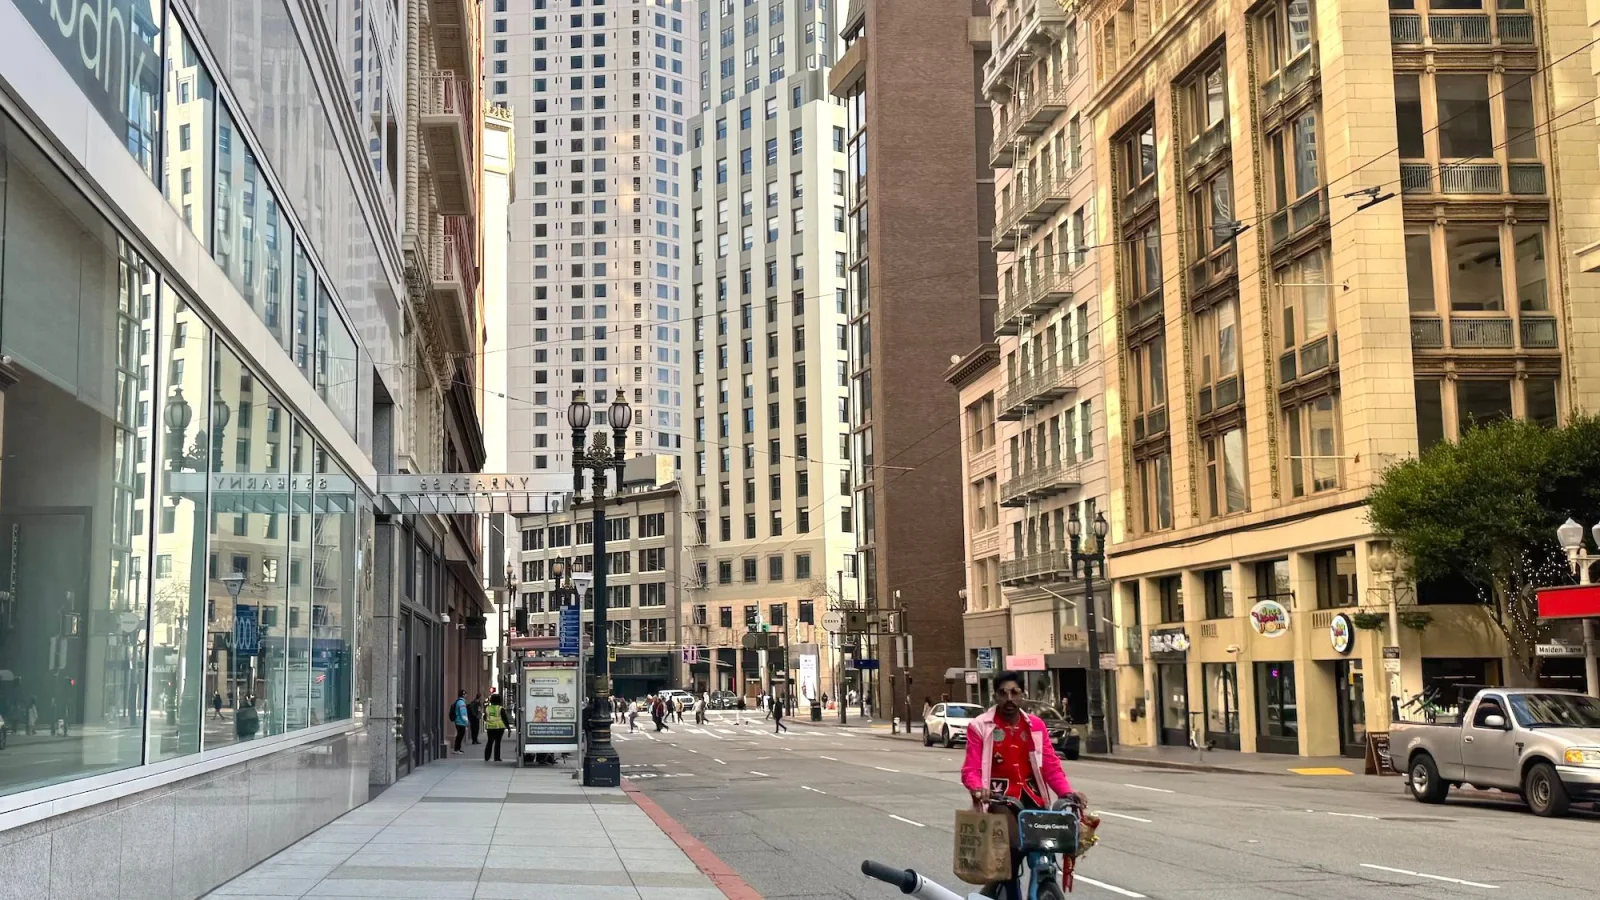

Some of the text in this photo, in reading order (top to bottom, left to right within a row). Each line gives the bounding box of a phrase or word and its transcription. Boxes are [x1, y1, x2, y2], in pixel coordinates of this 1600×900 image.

[449, 477, 530, 491] KEARNY
[1539, 645, 1582, 654] Maiden Lane
[1033, 822, 1052, 830] Google
